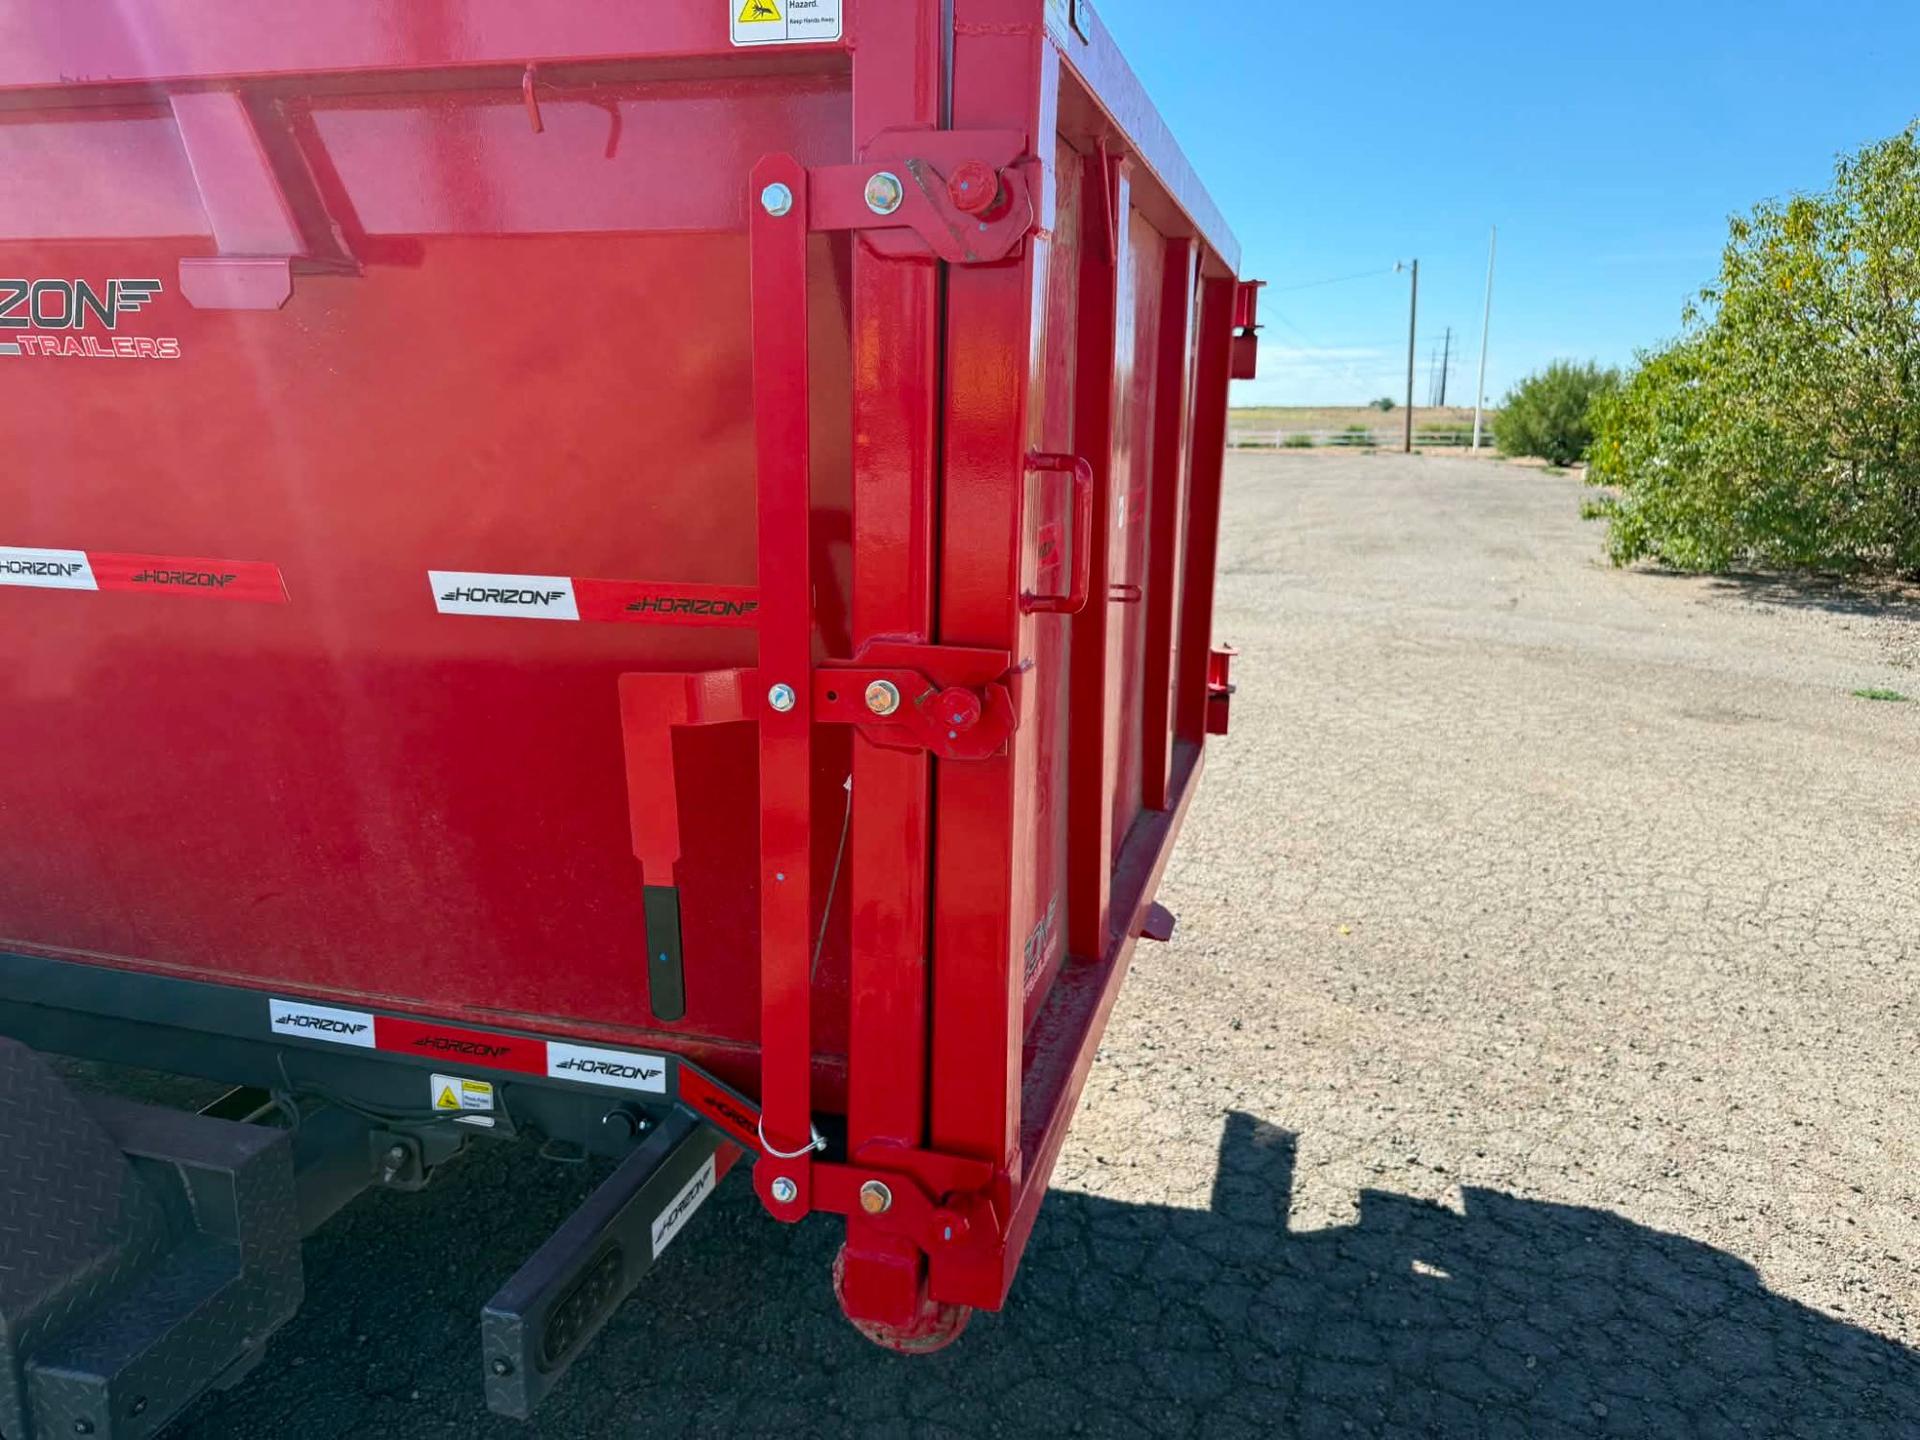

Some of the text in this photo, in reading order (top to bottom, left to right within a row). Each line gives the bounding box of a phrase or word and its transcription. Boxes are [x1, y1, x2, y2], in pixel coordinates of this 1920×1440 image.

[17, 335, 181, 358] TRAILERS
[0, 560, 72, 577] HORIZON
[142, 569, 225, 588] HORIZON
[454, 586, 551, 605] HORIZON
[641, 596, 743, 616] HORIZON
[285, 1014, 358, 1035] HORIZON
[422, 1036, 502, 1058] HORIZON
[567, 1058, 650, 1080] HORIZON
